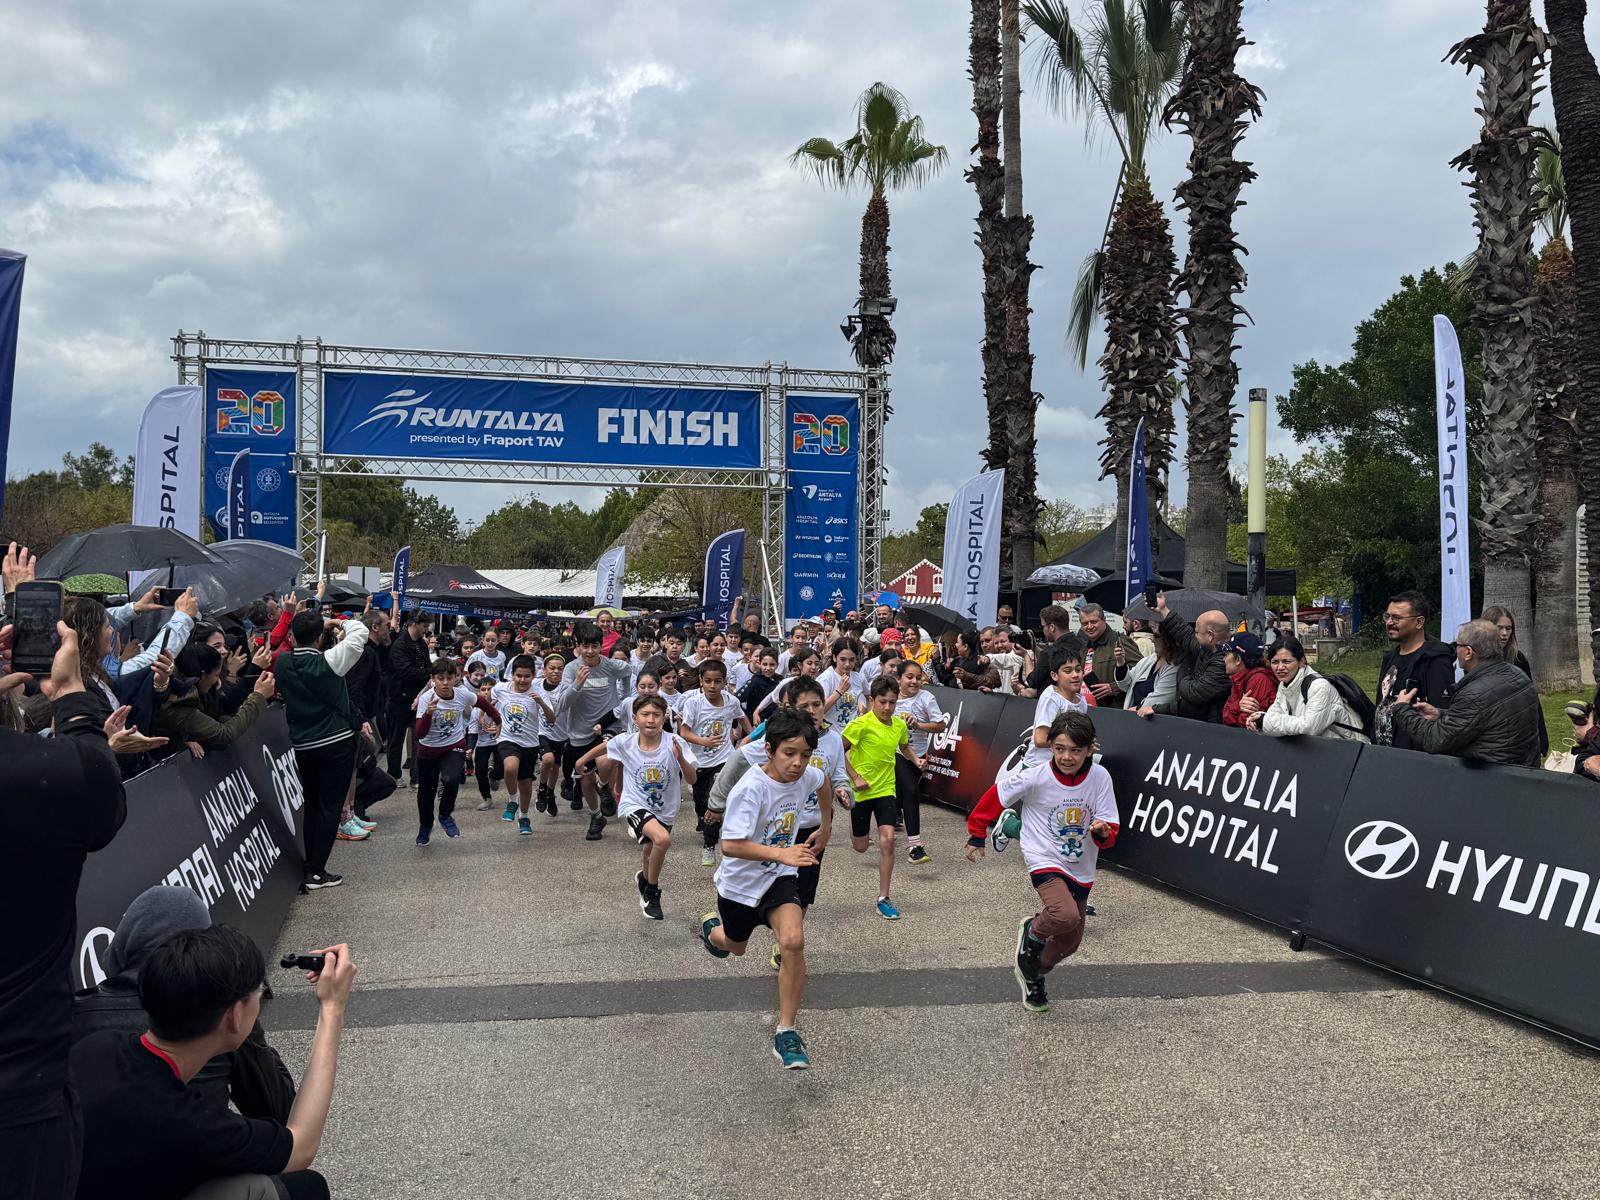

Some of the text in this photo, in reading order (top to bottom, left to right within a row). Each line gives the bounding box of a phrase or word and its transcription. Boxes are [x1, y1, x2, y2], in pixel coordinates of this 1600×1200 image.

[217, 388, 285, 436] 20
[409, 407, 564, 432] RUNTALYA
[598, 407, 739, 447] FINISH
[793, 412, 849, 455] 20
[410, 434, 564, 447] presented by Fraport TAV
[967, 493, 984, 595] HOSPITAL
[473, 607, 531, 620] KIDS RACE
[200, 767, 259, 848] ANATOLIA
[1144, 749, 1298, 818] ANATOLIA
[1069, 810, 1078, 824] 1
[1129, 793, 1279, 874] HOSPITAL
[161, 843, 225, 910] DAI
[224, 818, 281, 912] HOSPITAL
